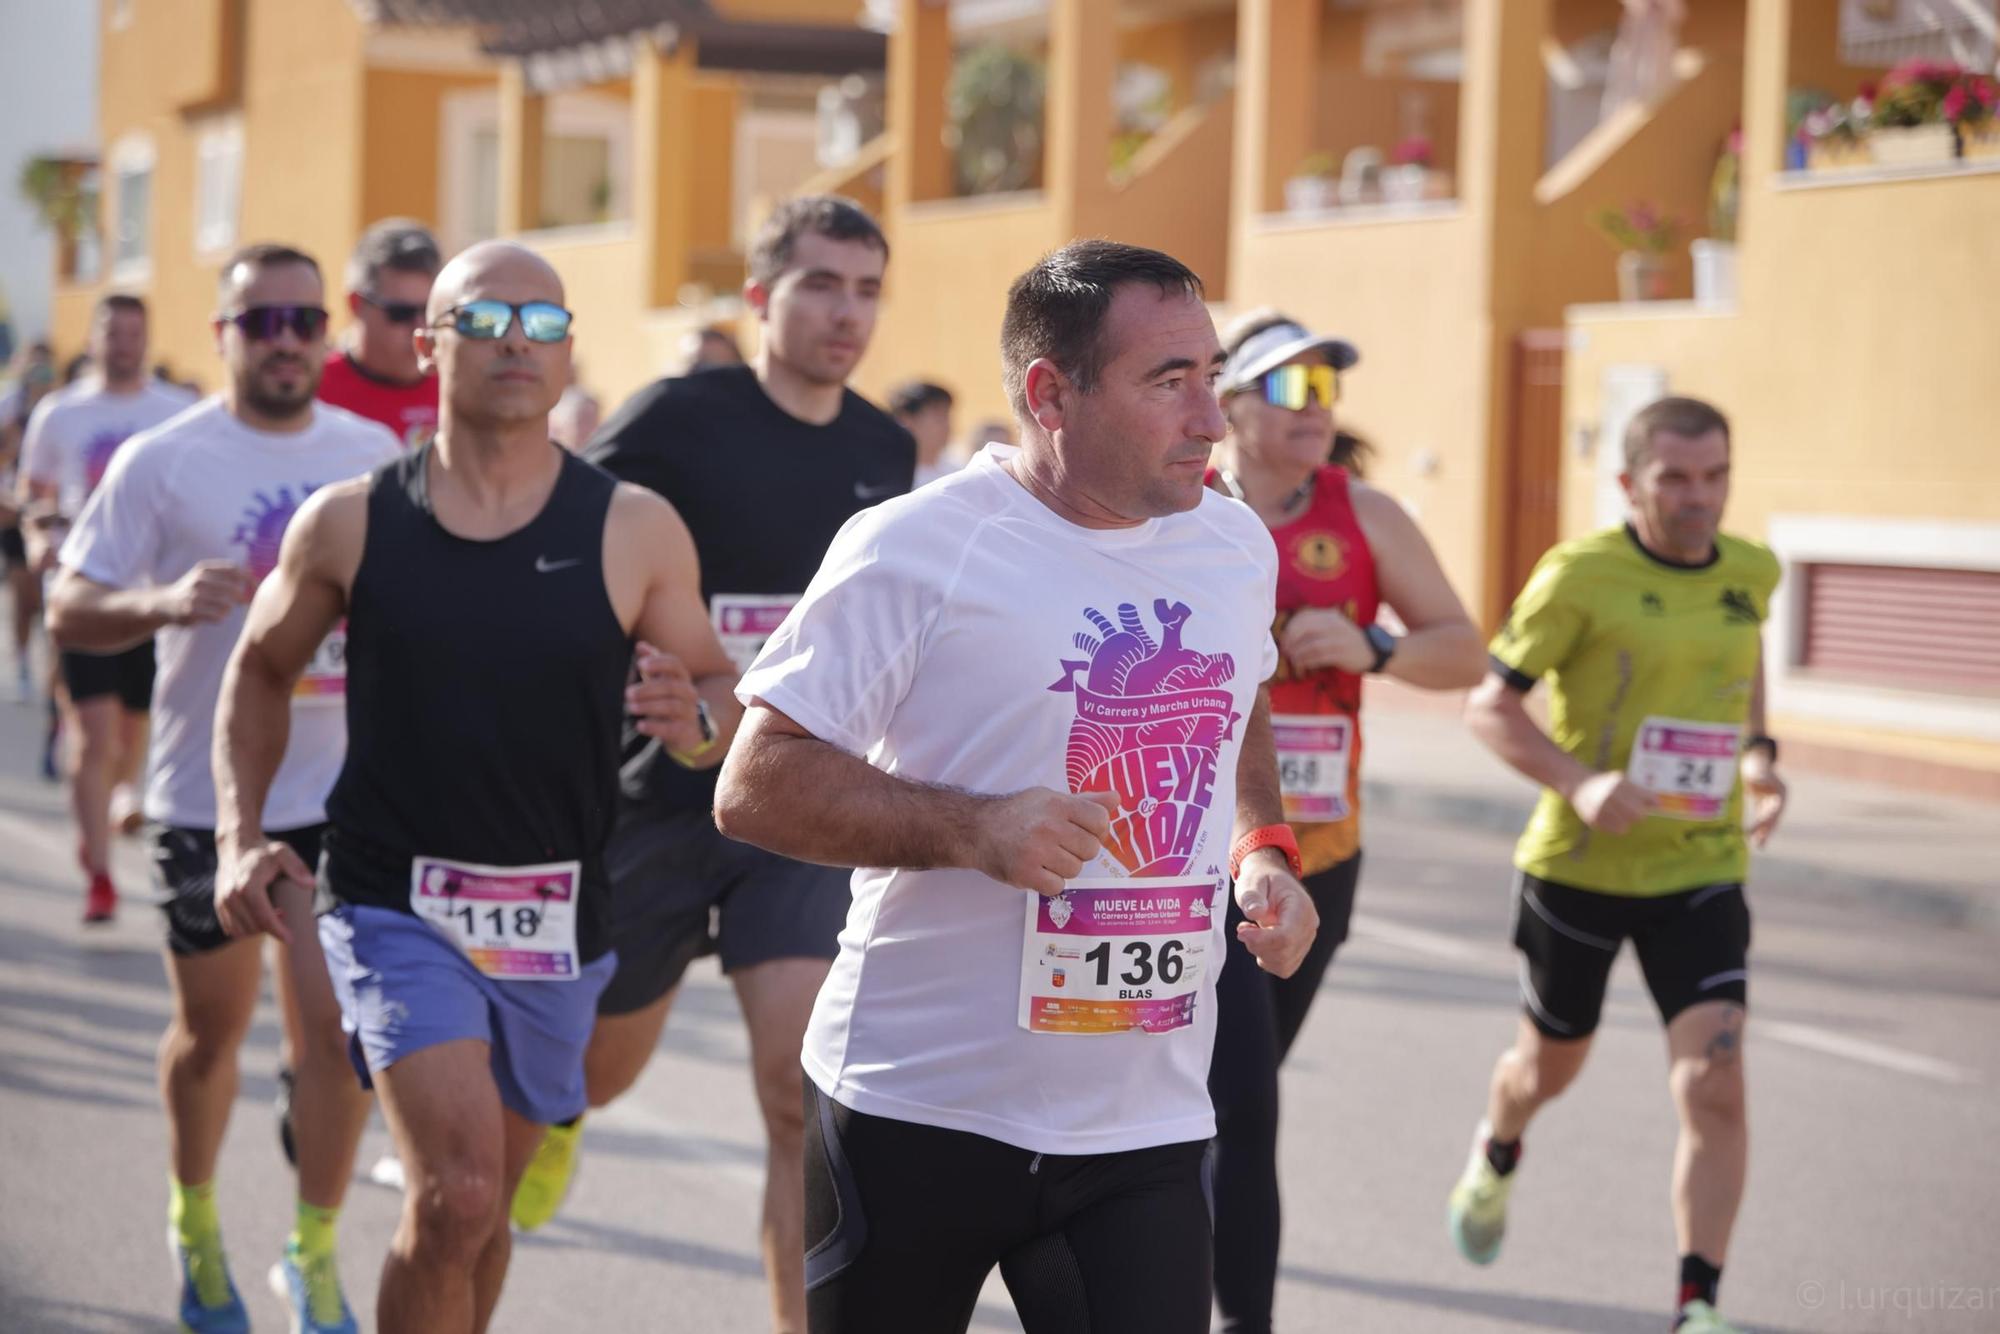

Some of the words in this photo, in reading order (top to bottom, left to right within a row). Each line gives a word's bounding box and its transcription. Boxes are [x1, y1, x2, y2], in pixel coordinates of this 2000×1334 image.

[1084, 701, 1095, 713] VI
[1096, 704, 1139, 717] Carrera
[1141, 707, 1148, 718] y
[1150, 699, 1189, 715] Marcha
[1191, 697, 1226, 709] Urbana
[1676, 759, 1714, 788] 24
[1103, 802, 1204, 870] VIDA
[1093, 899, 1138, 912] MUEVE
[1140, 899, 1154, 911] LA
[1156, 897, 1181, 910] VIDA
[1101, 912, 1128, 920] Carrera
[1135, 911, 1159, 919] Marcha
[457, 905, 539, 937] 118
[1085, 940, 1184, 986] 136
[1119, 989, 1153, 999] BLAS
